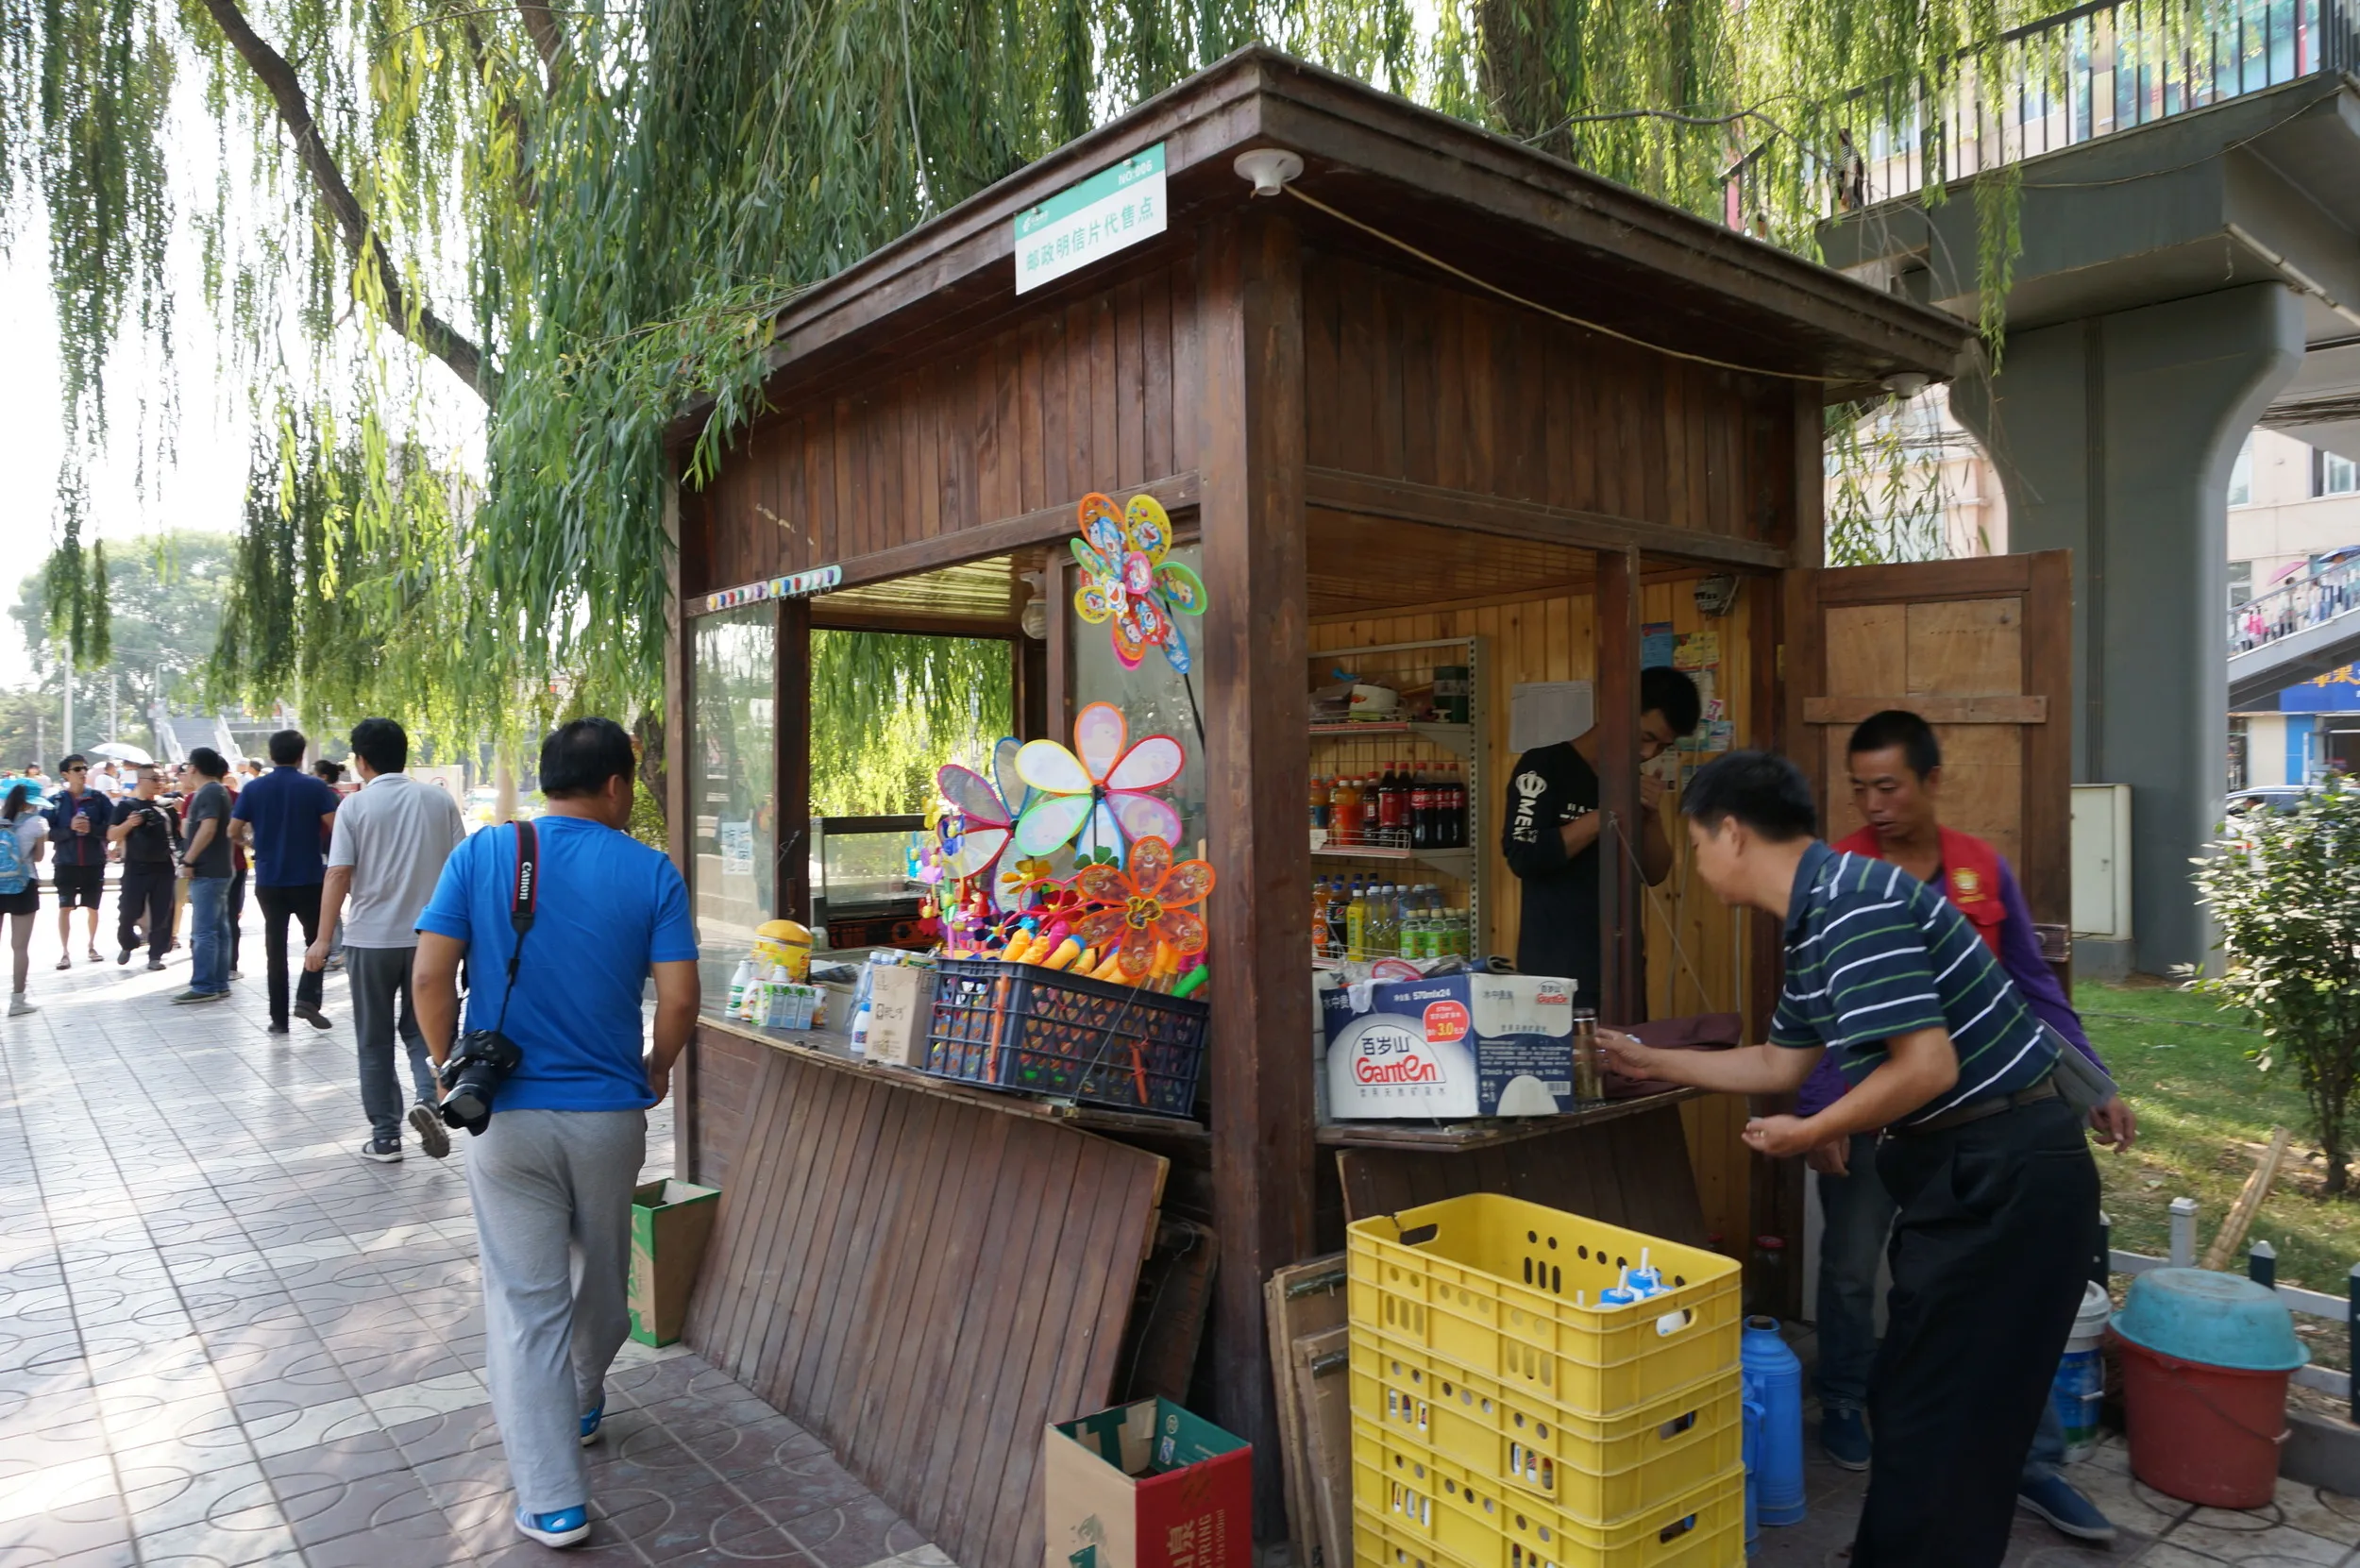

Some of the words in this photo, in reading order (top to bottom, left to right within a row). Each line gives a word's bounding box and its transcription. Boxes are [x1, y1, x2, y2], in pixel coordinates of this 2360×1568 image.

[1026, 196, 1154, 272] 邮政明信片代售点
[519, 861, 532, 900] Canon
[1483, 989, 1514, 1000] 水中
[1361, 1036, 1410, 1055] 百岁山
[1356, 1054, 1437, 1083] Ganten
